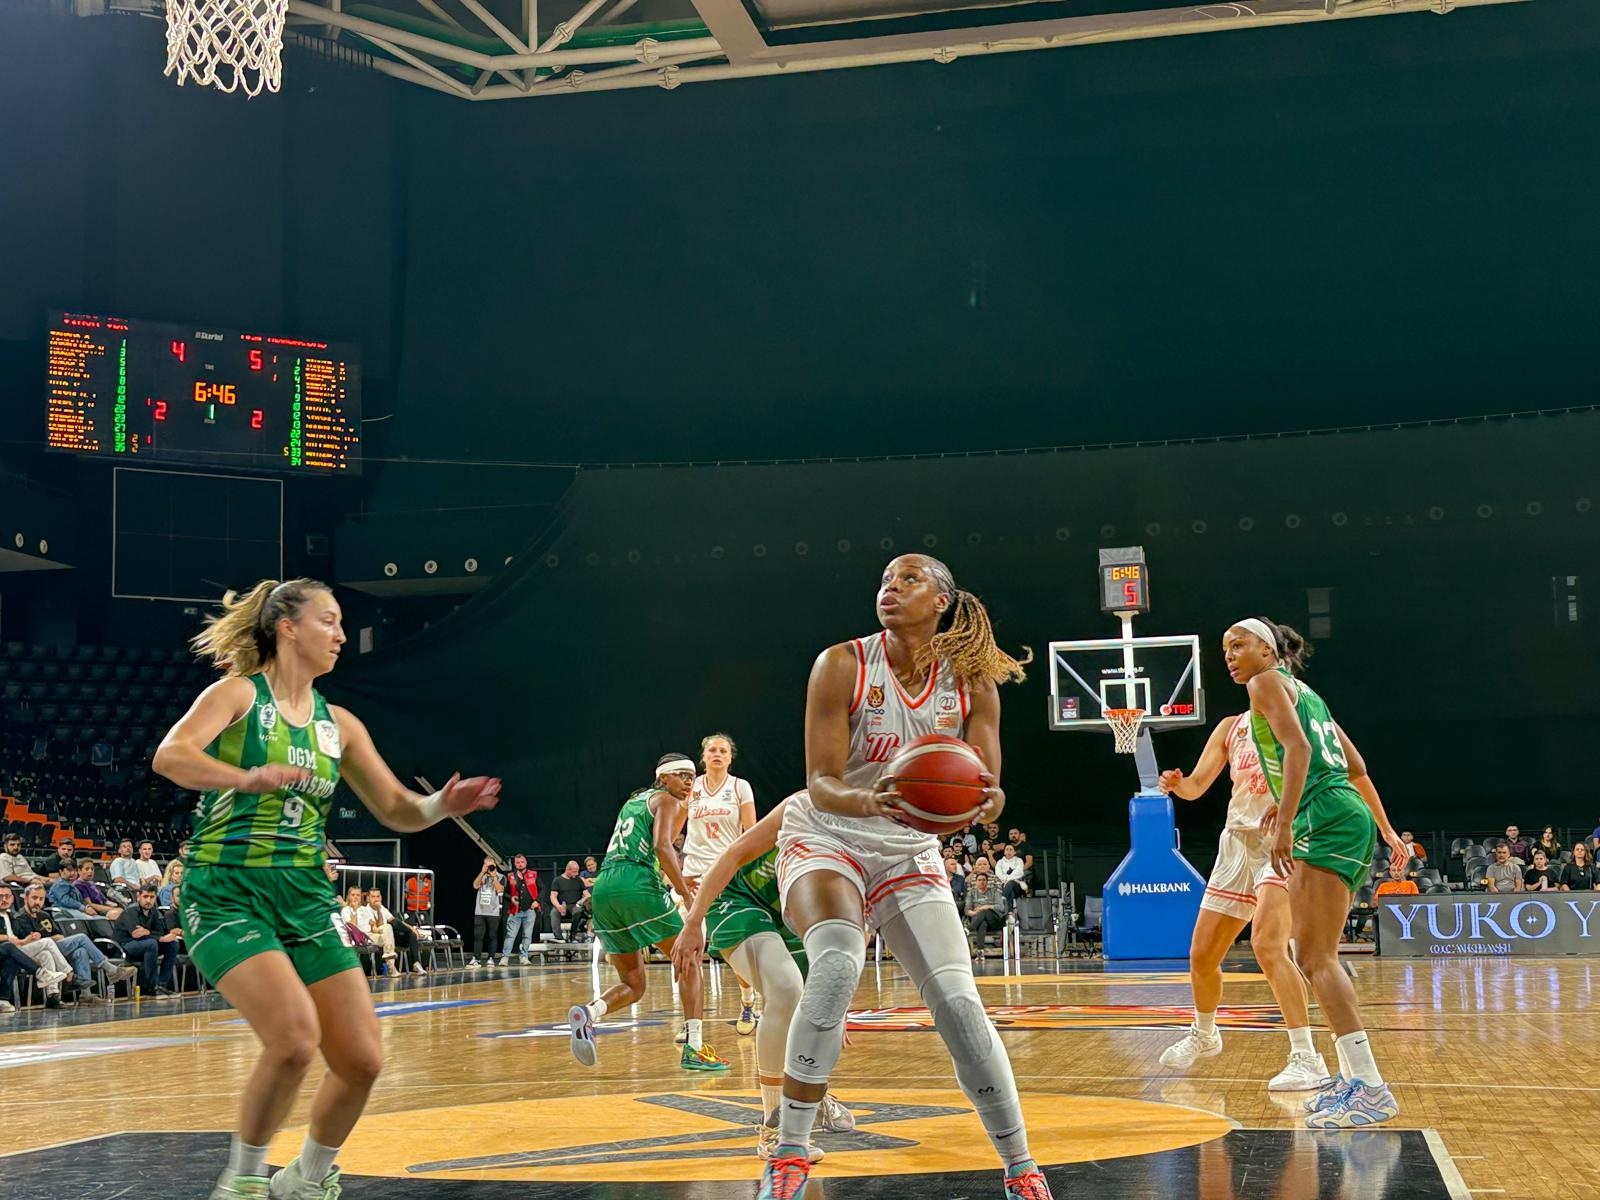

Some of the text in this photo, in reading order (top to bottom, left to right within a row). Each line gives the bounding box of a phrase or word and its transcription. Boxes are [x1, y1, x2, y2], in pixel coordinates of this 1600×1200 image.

[172, 341, 185, 362] 4
[250, 351, 262, 369] 5
[195, 382, 236, 404] 6:46
[155, 402, 166, 420] 2
[210, 404, 214, 419] 1
[252, 410, 262, 428] 2
[1112, 566, 1139, 580] 6:46
[1124, 582, 1138, 606] 5
[1172, 704, 1193, 714] TBF
[288, 745, 318, 770] OGM
[280, 796, 304, 828] 9
[607, 817, 635, 853] 22
[1132, 882, 1190, 894] HALKBANK
[1385, 900, 1556, 940] YUKO
